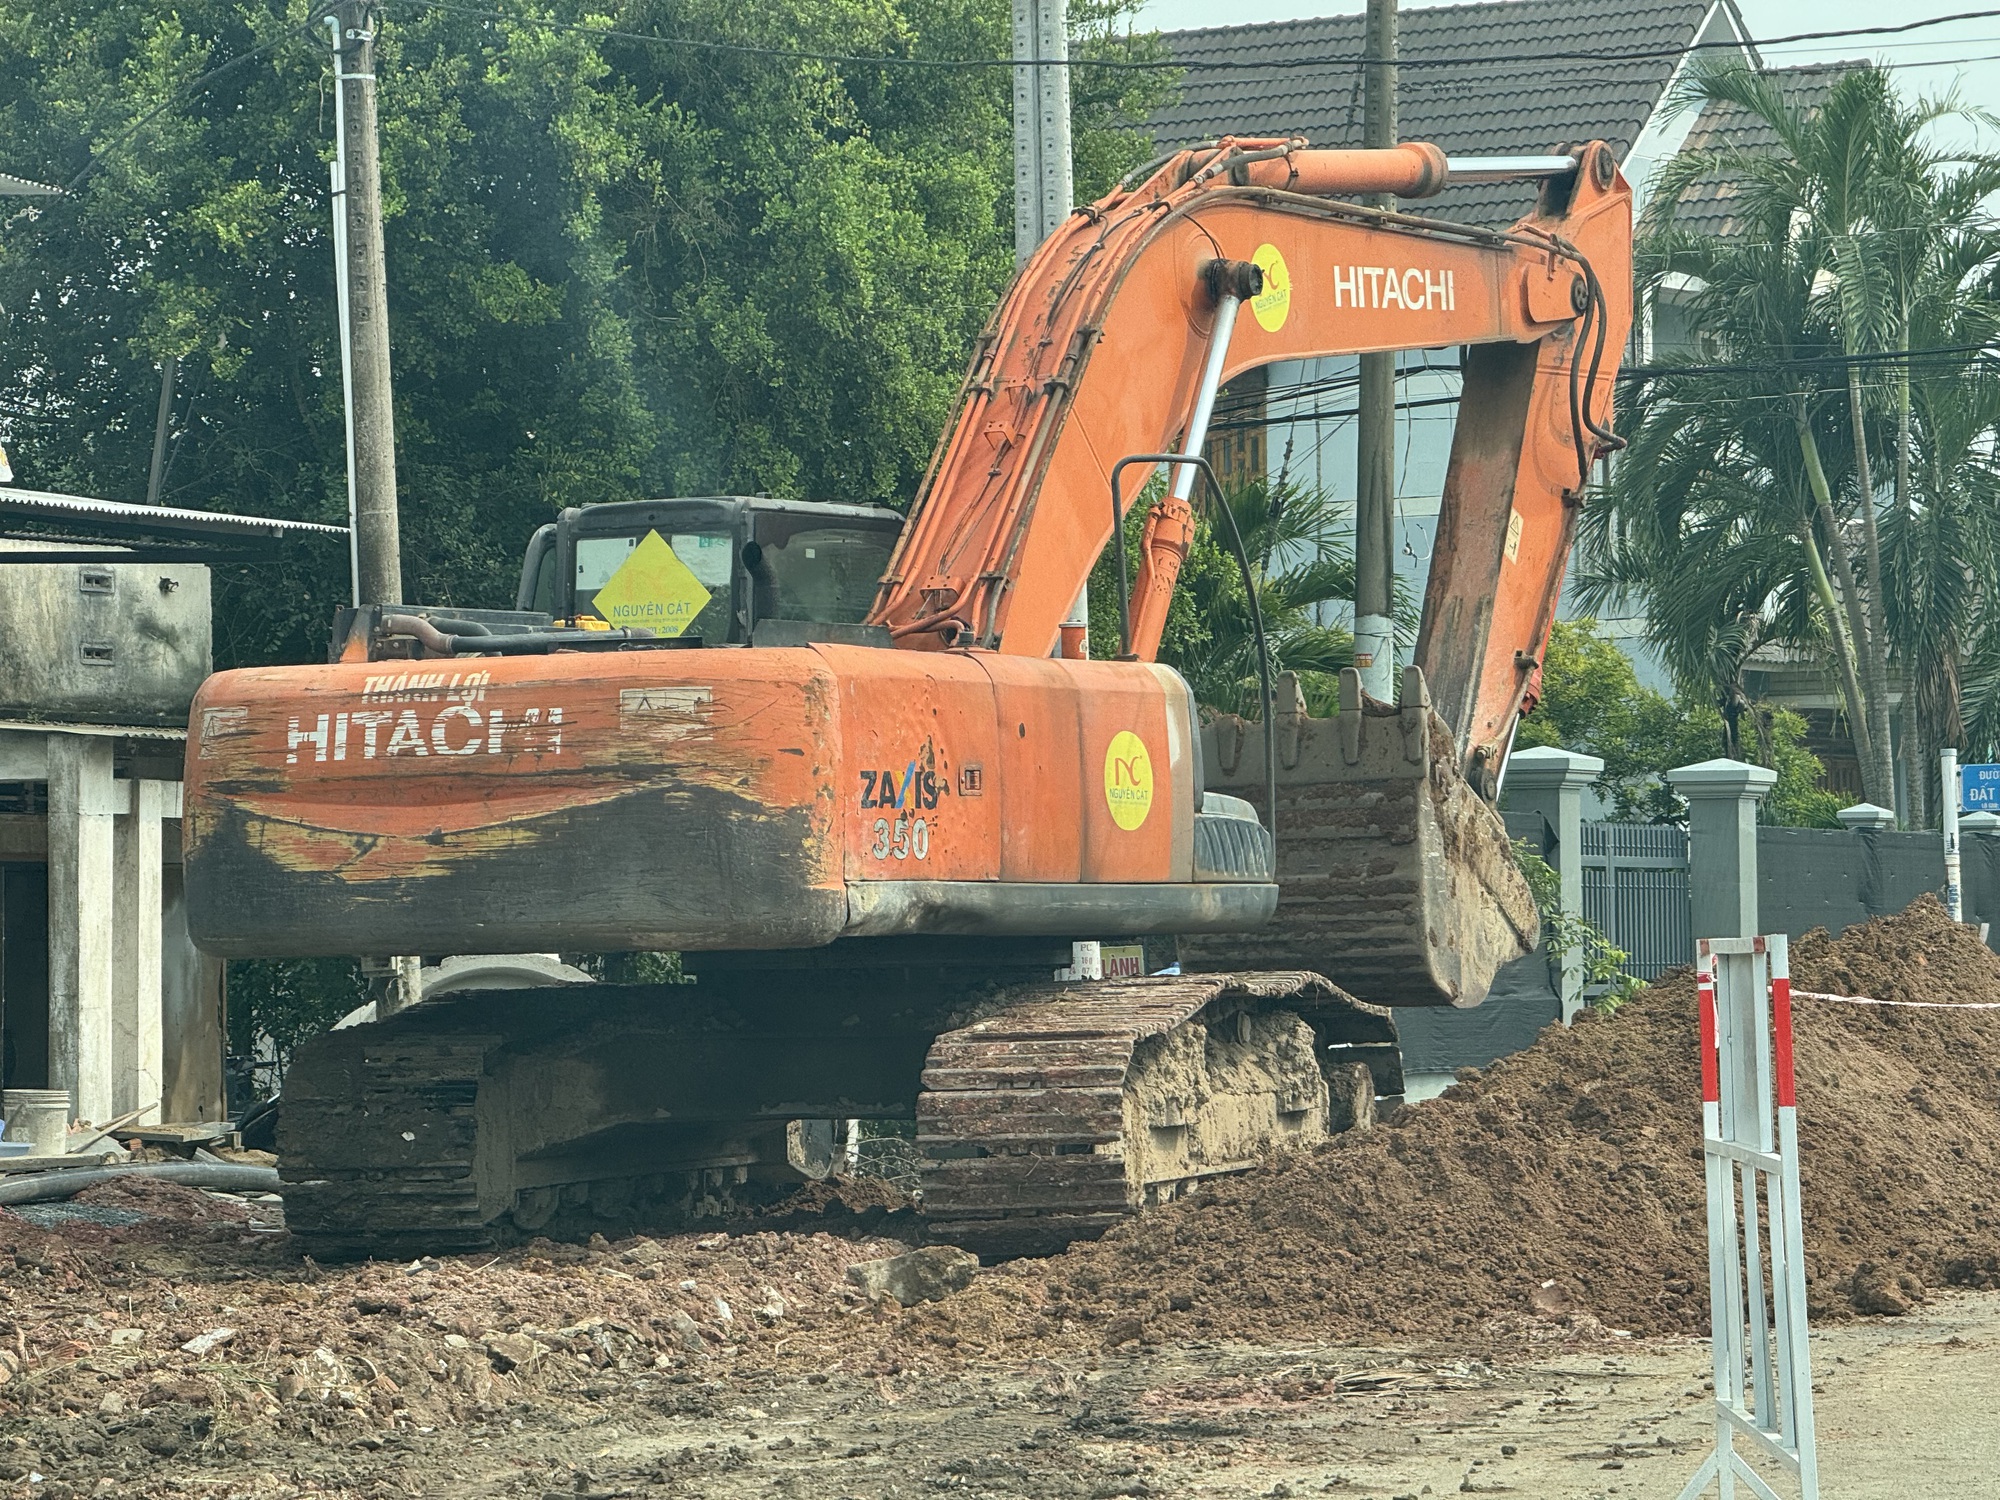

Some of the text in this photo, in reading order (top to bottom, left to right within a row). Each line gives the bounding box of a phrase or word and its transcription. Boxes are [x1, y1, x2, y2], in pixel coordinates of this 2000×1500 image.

[1333, 265, 1455, 311] HITACHI
[613, 600, 691, 617] NGUYÊN CÁT
[286, 705, 563, 764] HITACHI
[860, 760, 938, 810] ZAXIS
[1969, 782, 1995, 801] ĐẤT
[872, 818, 929, 860] 350
[1101, 954, 1140, 977] LÀNH
